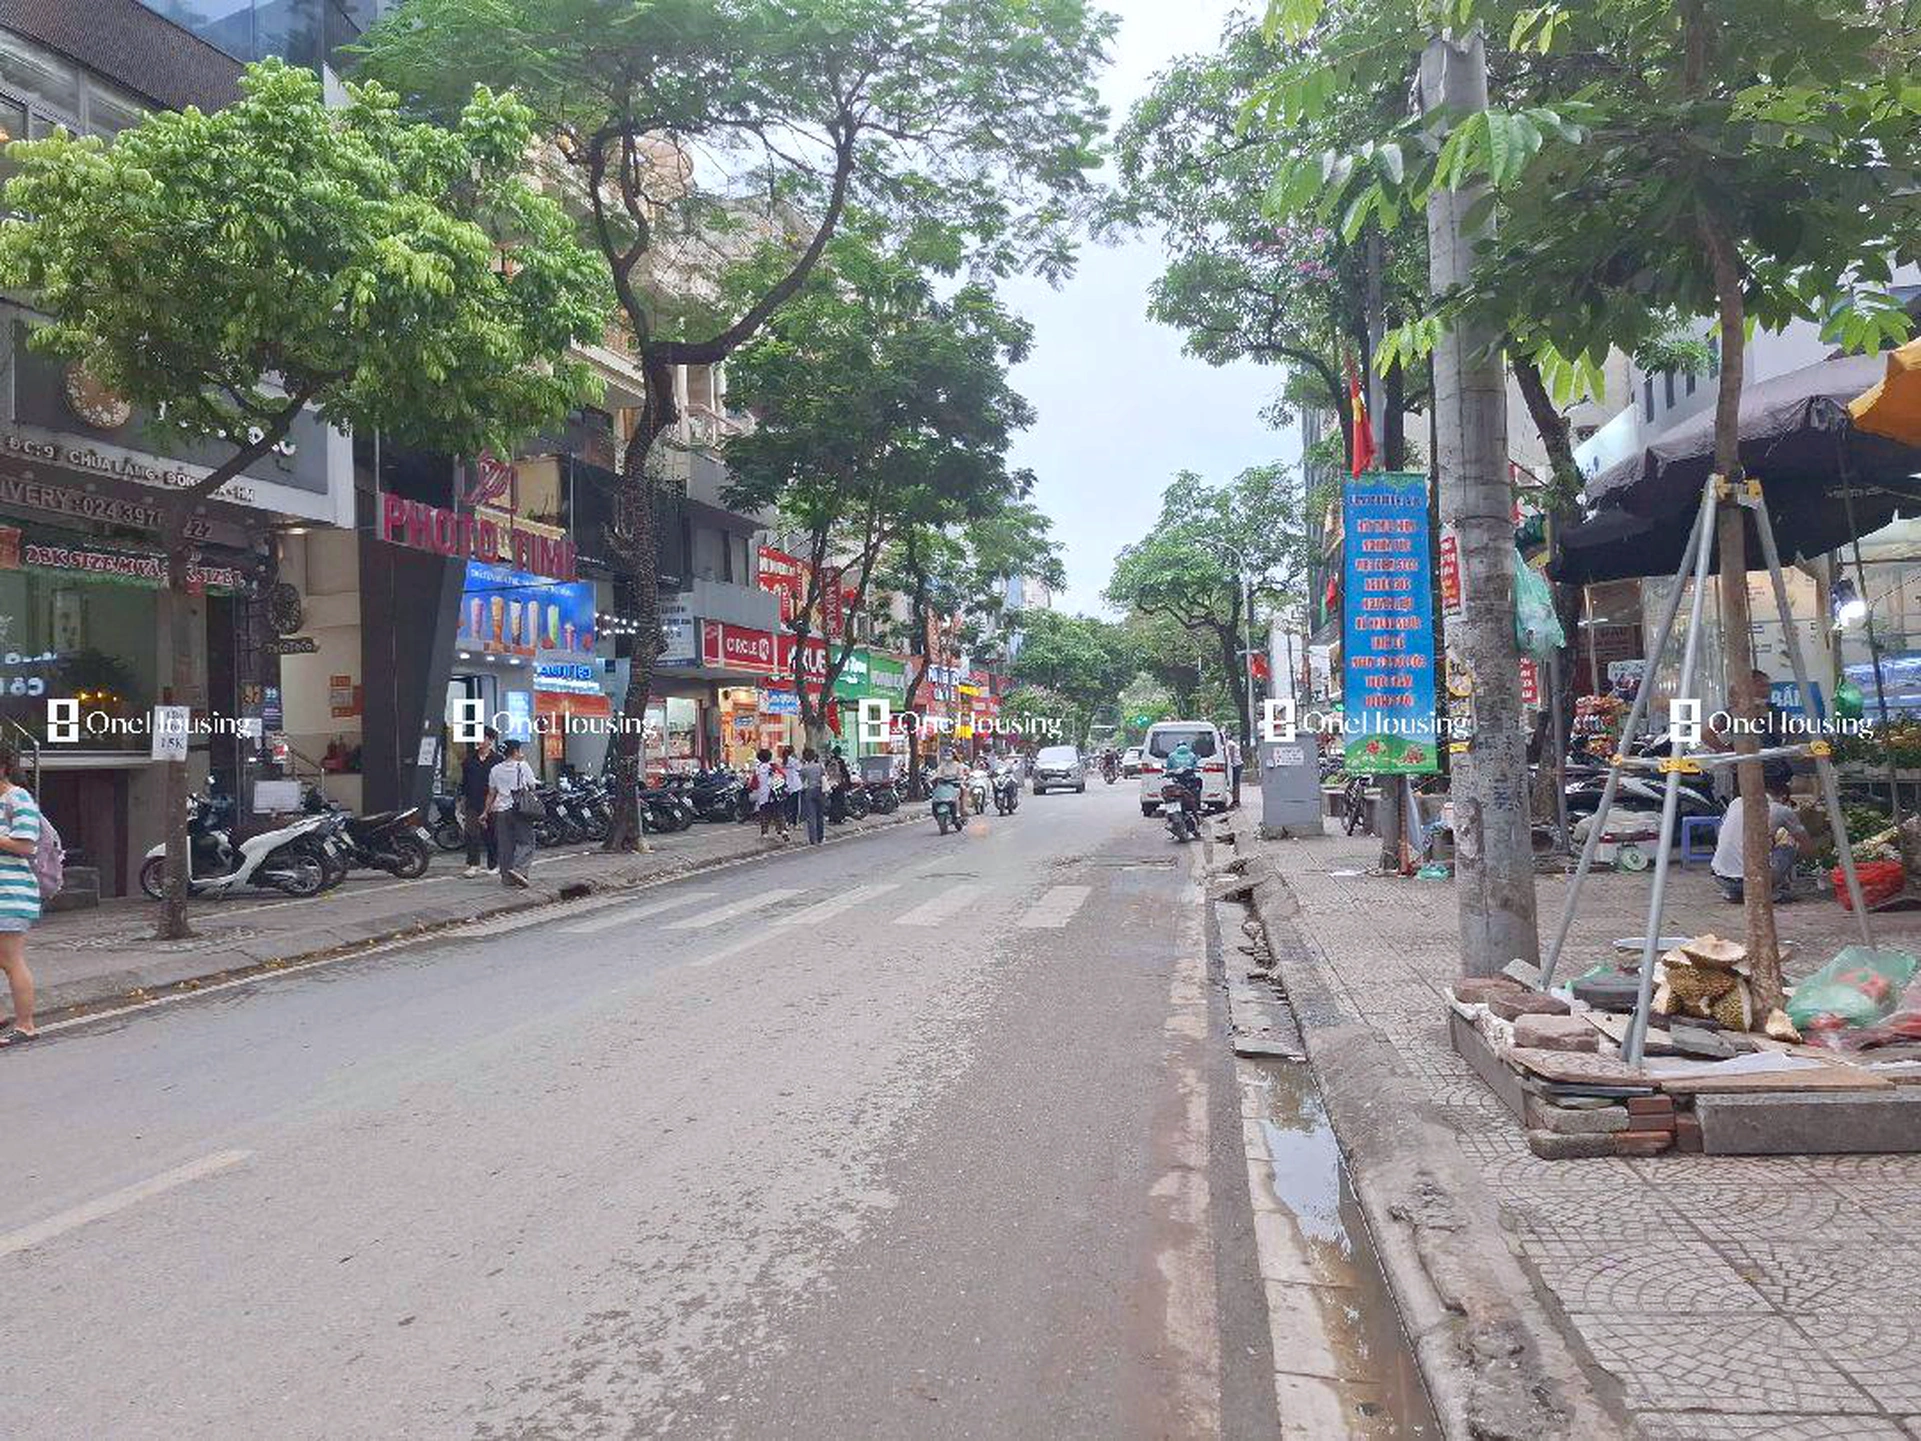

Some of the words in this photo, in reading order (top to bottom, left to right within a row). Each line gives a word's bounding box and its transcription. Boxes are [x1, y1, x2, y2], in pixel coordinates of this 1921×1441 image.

[384, 492, 499, 564] PHOTO
[512, 527, 582, 583] TIME
[726, 637, 758, 655] CIRCLE
